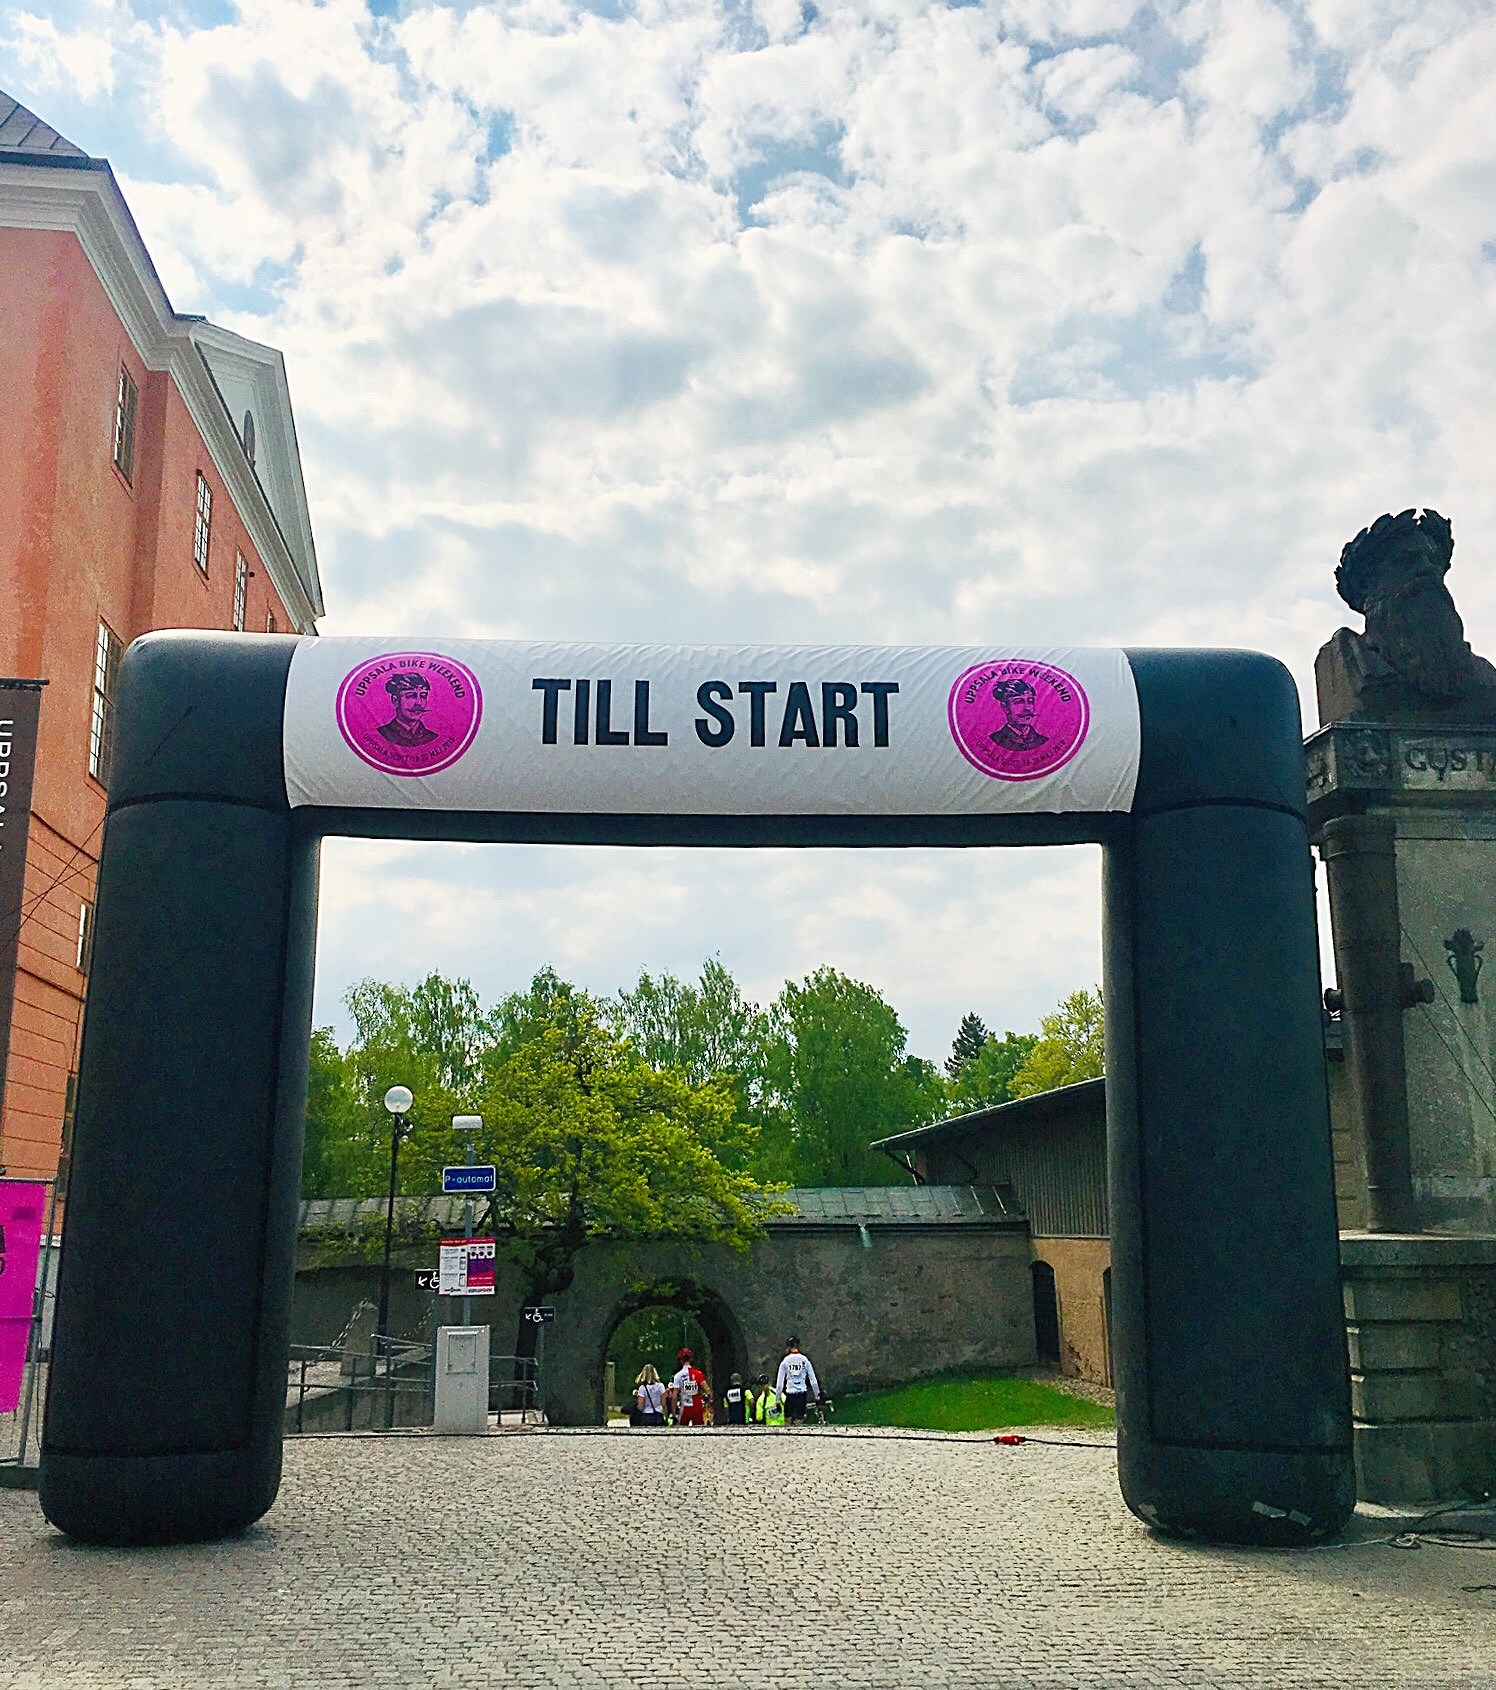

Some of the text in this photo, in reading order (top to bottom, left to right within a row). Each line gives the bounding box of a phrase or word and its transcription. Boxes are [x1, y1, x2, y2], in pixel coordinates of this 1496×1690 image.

[354, 660, 466, 699] UPPSALA BIKE WEEKEND
[964, 667, 1072, 704] UPPSALA BIKE WEEKEND
[532, 678, 900, 748] TILL START
